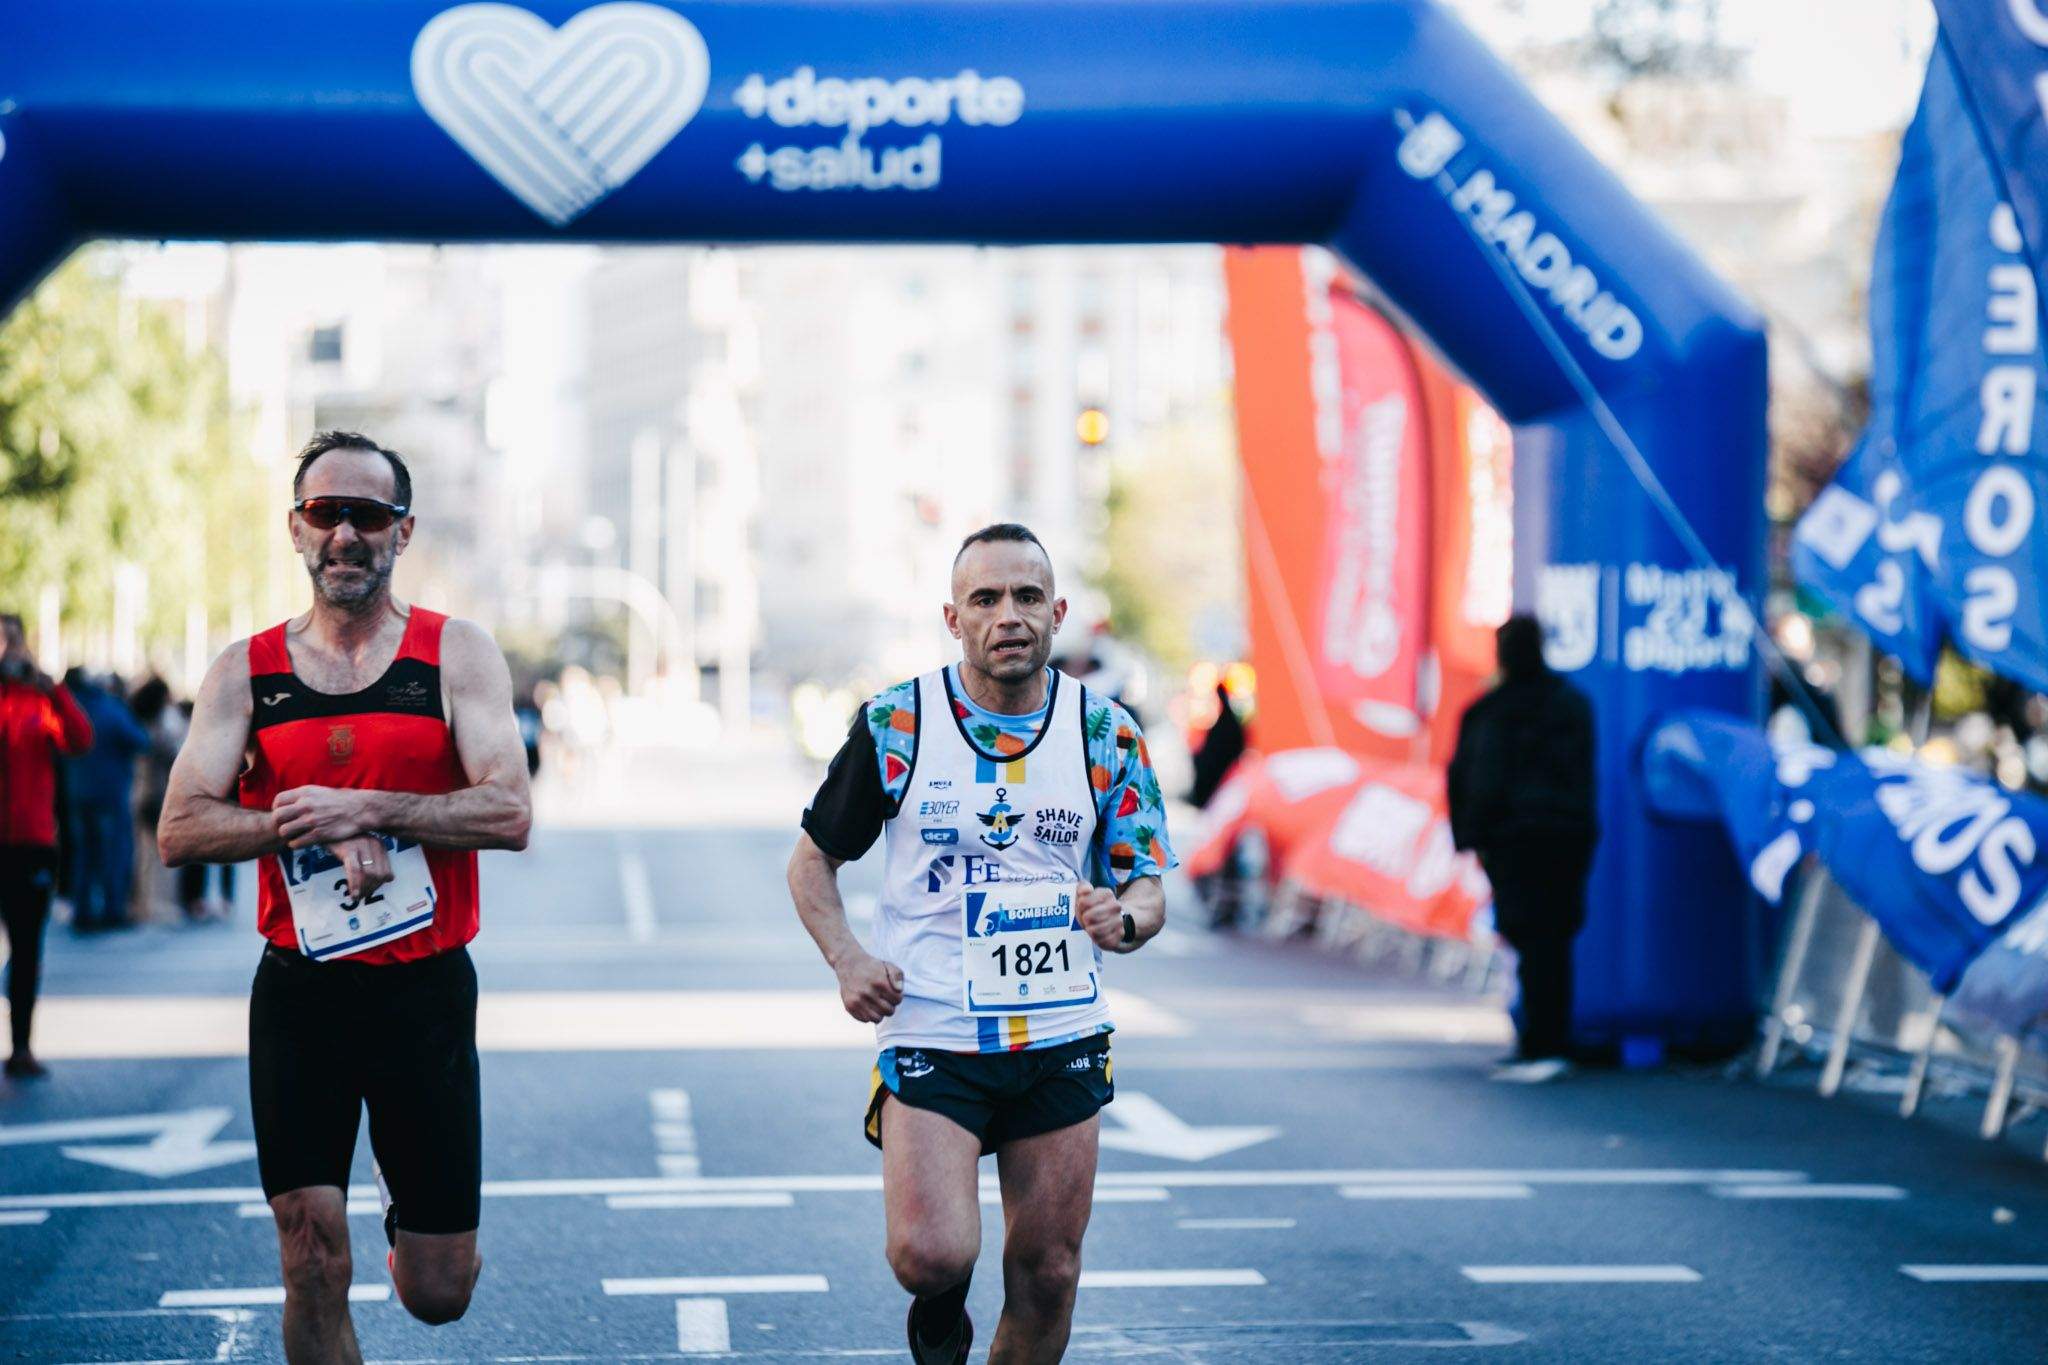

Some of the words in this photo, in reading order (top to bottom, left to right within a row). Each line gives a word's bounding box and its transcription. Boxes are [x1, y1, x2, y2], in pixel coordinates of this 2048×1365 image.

[1451, 169, 1643, 361] MADRID
[1036, 808, 1083, 828] SHAVE
[1033, 825, 1079, 843] SAILOR
[1008, 904, 1068, 920] BOMBEROS
[992, 939, 1070, 976] 1821
